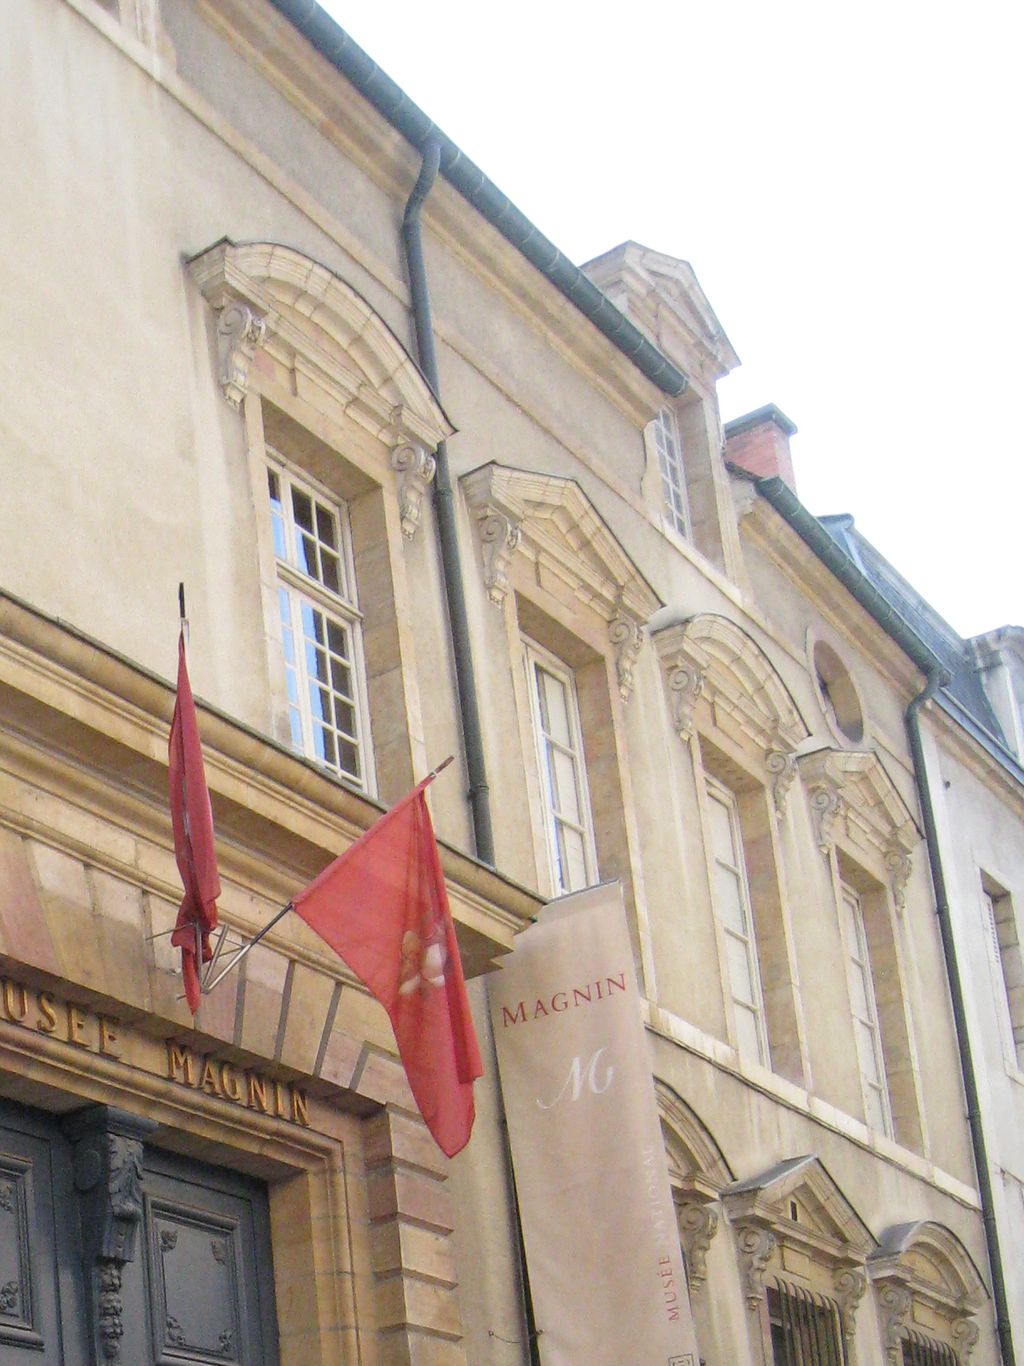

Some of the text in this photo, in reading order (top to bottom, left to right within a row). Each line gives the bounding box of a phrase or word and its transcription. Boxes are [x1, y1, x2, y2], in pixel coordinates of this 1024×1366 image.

[500, 973, 626, 1028] MAGNIN
[164, 1036, 311, 1127] MAGNIN
[657, 1255, 680, 1321] MUSÉE
